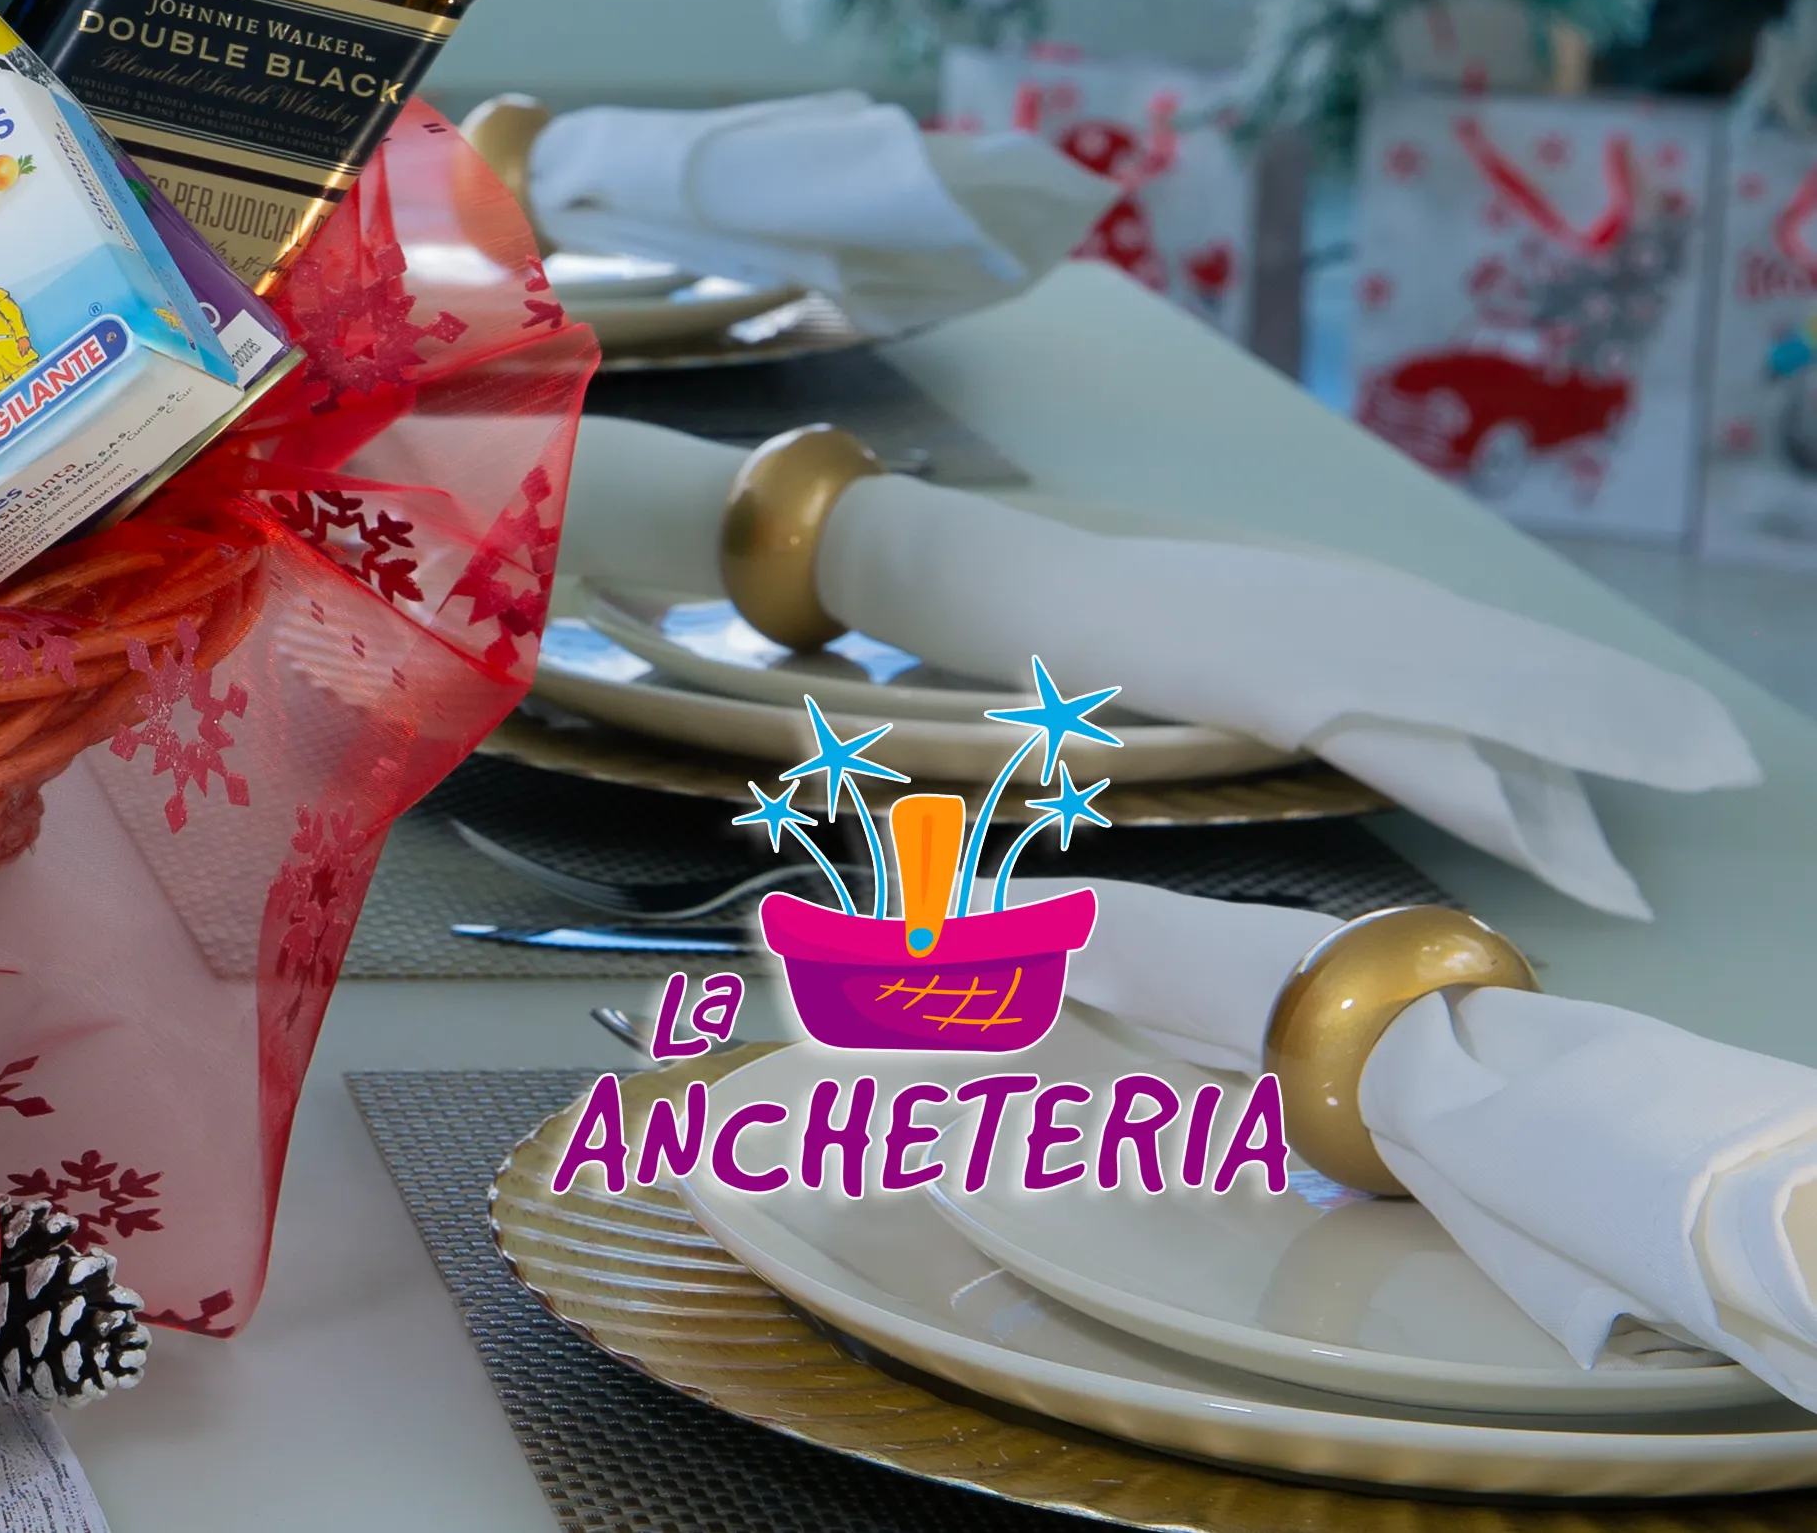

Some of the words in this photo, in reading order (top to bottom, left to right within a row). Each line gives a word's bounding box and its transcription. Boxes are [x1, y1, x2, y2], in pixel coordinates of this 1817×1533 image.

[79, 10, 248, 69] DOUBLE
[267, 52, 403, 105] BLACK
[267, 19, 364, 59] WALKER
